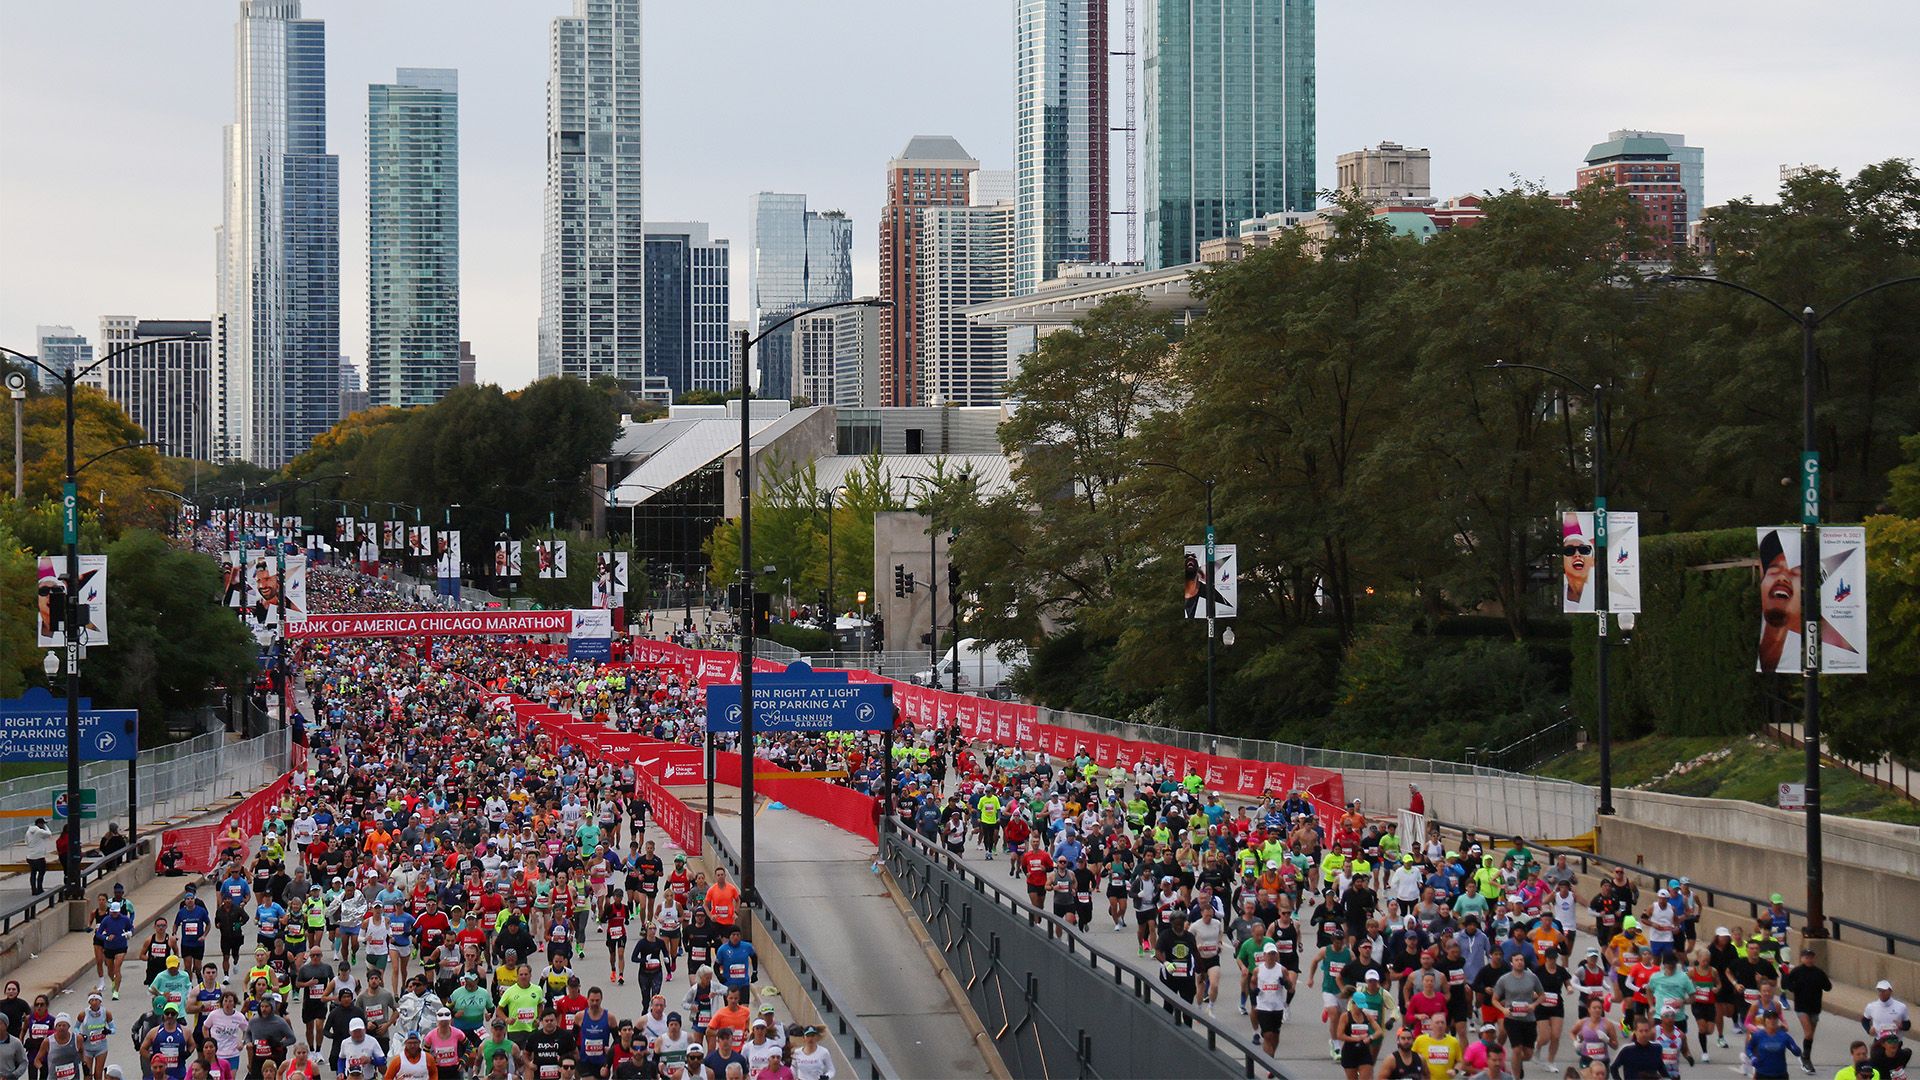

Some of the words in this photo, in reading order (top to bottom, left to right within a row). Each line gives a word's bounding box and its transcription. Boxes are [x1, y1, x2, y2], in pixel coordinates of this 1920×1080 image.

[1805, 459, 1818, 517] C10N
[64, 496, 76, 532] C11
[1596, 508, 1606, 536] C10
[289, 620, 329, 633] BANK
[332, 620, 351, 632] OF
[354, 618, 418, 632] AMERICA
[421, 617, 482, 630] CHICAGO
[486, 616, 565, 630] MARATHON
[1807, 624, 1817, 666] C10N
[68, 645, 76, 671] C11
[774, 689, 807, 698] RIGHT
[810, 689, 825, 698] AT
[828, 688, 860, 697] LIGHT
[753, 701, 775, 709] FOR
[780, 700, 829, 709] PARKING
[832, 700, 847, 708] AT
[5, 718, 42, 727] RIGHT
[45, 717, 62, 726] AT
[65, 717, 100, 726] LGHT
[12, 729, 66, 738] PARKING
